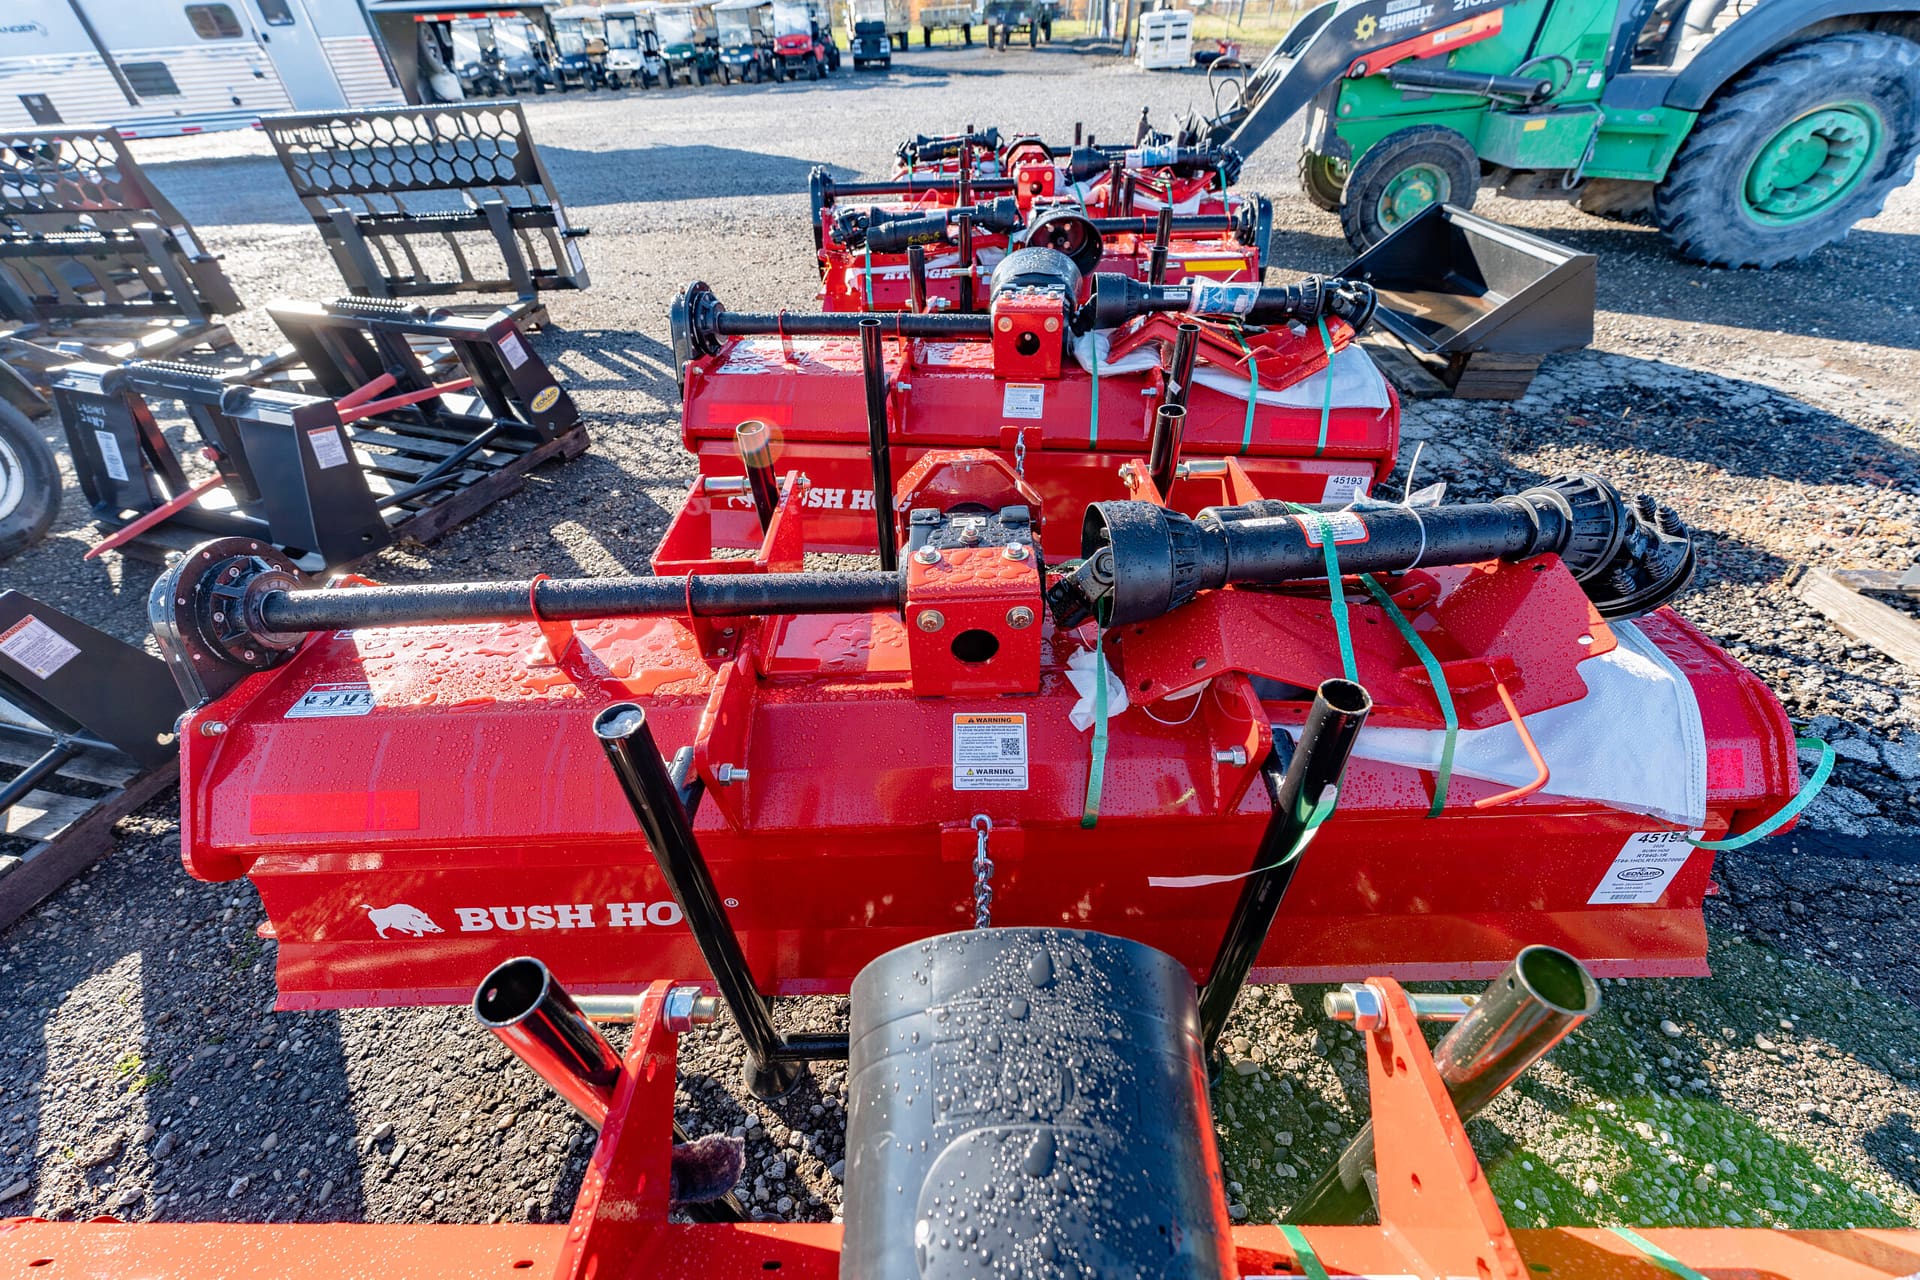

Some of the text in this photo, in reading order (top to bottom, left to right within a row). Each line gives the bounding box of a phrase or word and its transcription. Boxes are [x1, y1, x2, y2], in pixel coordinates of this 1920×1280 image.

[1378, 4, 1434, 29] SUNBELT
[1333, 476, 1363, 485] 45193
[1637, 832, 1690, 843] 4519
[454, 901, 684, 932] BUSH HO
